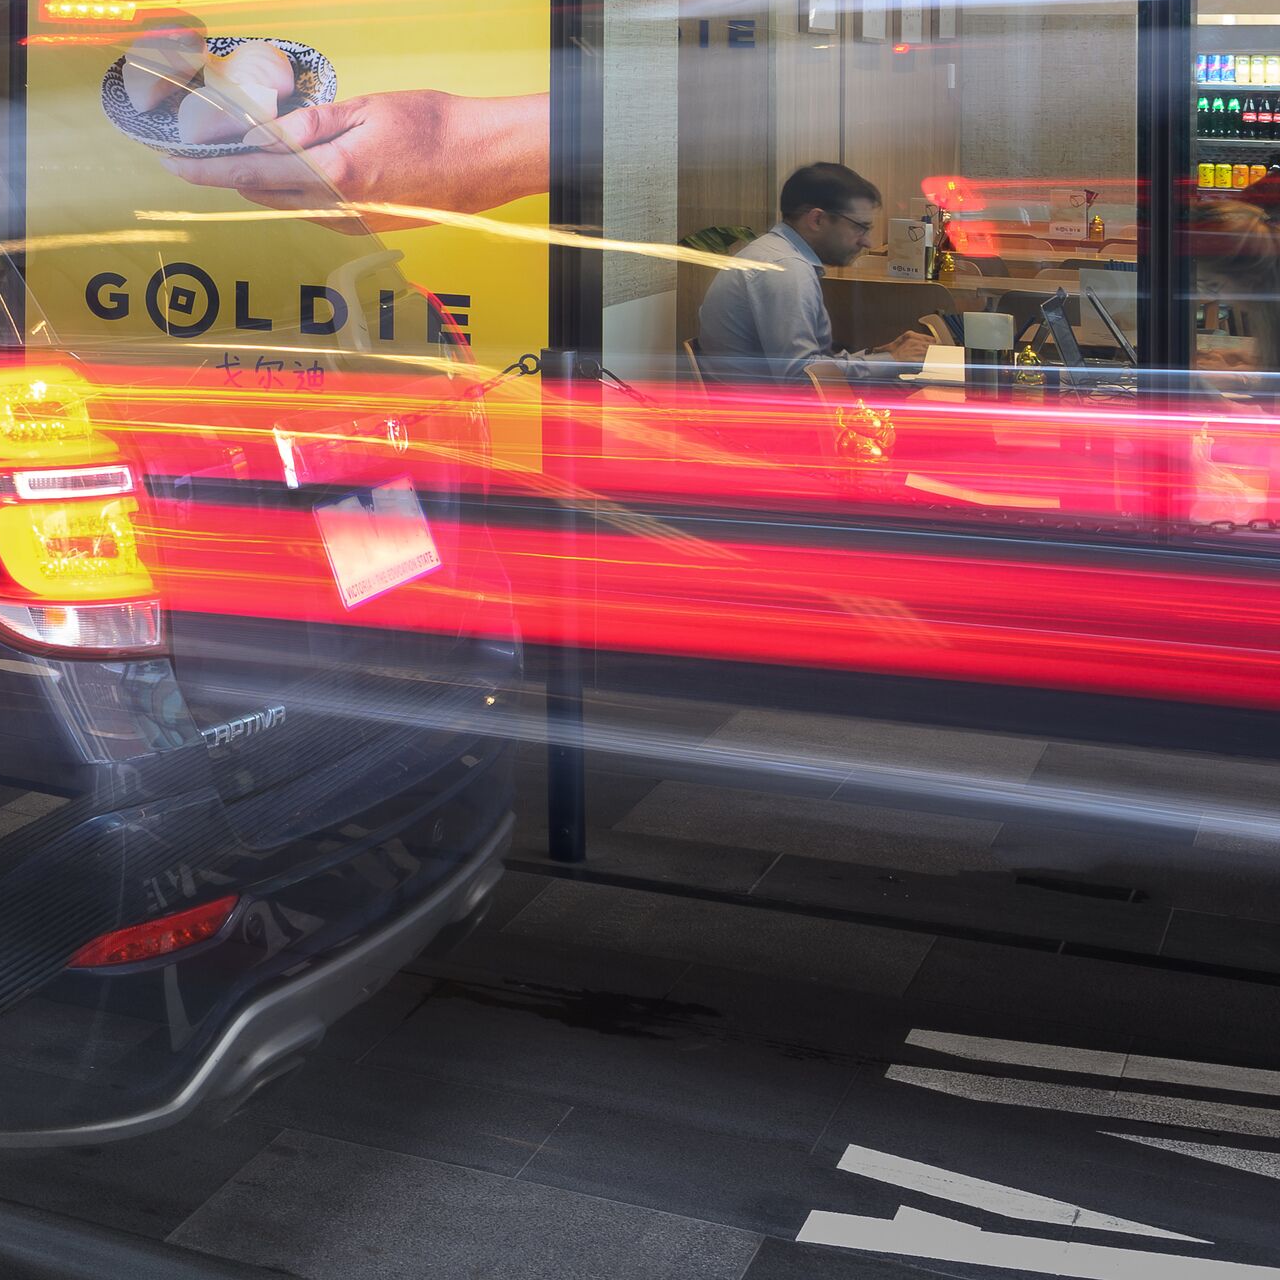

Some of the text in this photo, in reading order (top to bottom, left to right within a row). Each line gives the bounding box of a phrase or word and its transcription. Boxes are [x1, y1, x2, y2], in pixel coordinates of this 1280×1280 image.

[892, 265, 919, 273] GOLDIE
[85, 261, 472, 345] GOLDIE
[418, 551, 435, 569] STATE
